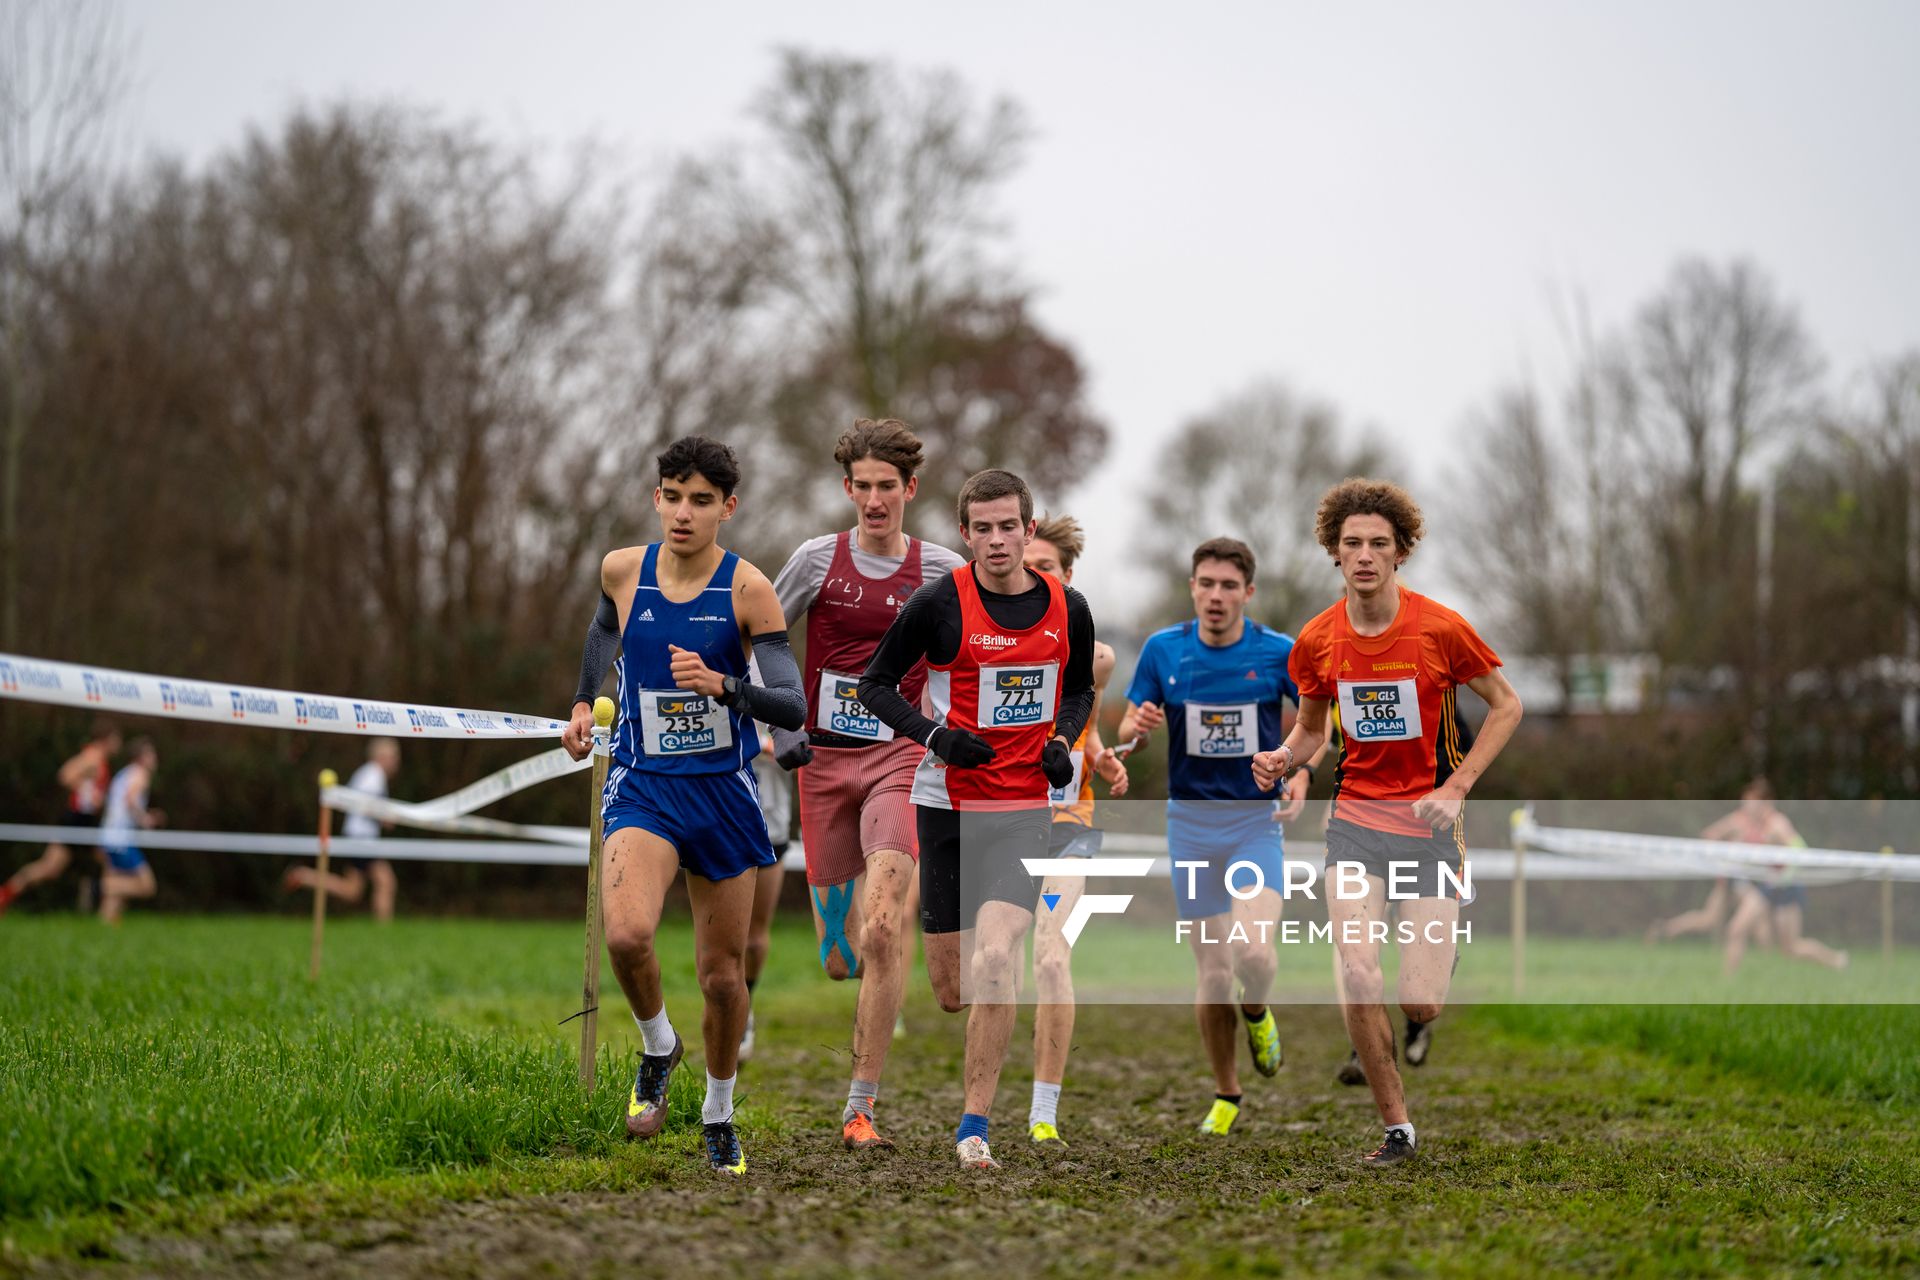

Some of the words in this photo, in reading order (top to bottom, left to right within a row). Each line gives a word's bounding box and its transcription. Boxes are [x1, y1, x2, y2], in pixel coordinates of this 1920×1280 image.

[983, 635, 1017, 646] Brillux
[1021, 675, 1040, 686] GLS
[1001, 690, 1036, 706] 771
[1378, 691, 1396, 701] GLS
[684, 701, 705, 713] GLS
[1014, 706, 1041, 717] PLAN
[1361, 704, 1396, 720] 166
[664, 715, 705, 733] 235
[849, 719, 878, 731] PLAN
[1376, 721, 1404, 730] PLAN
[682, 732, 713, 744] PLAN
[1206, 726, 1237, 740] 734
[1218, 741, 1243, 749] PLAN
